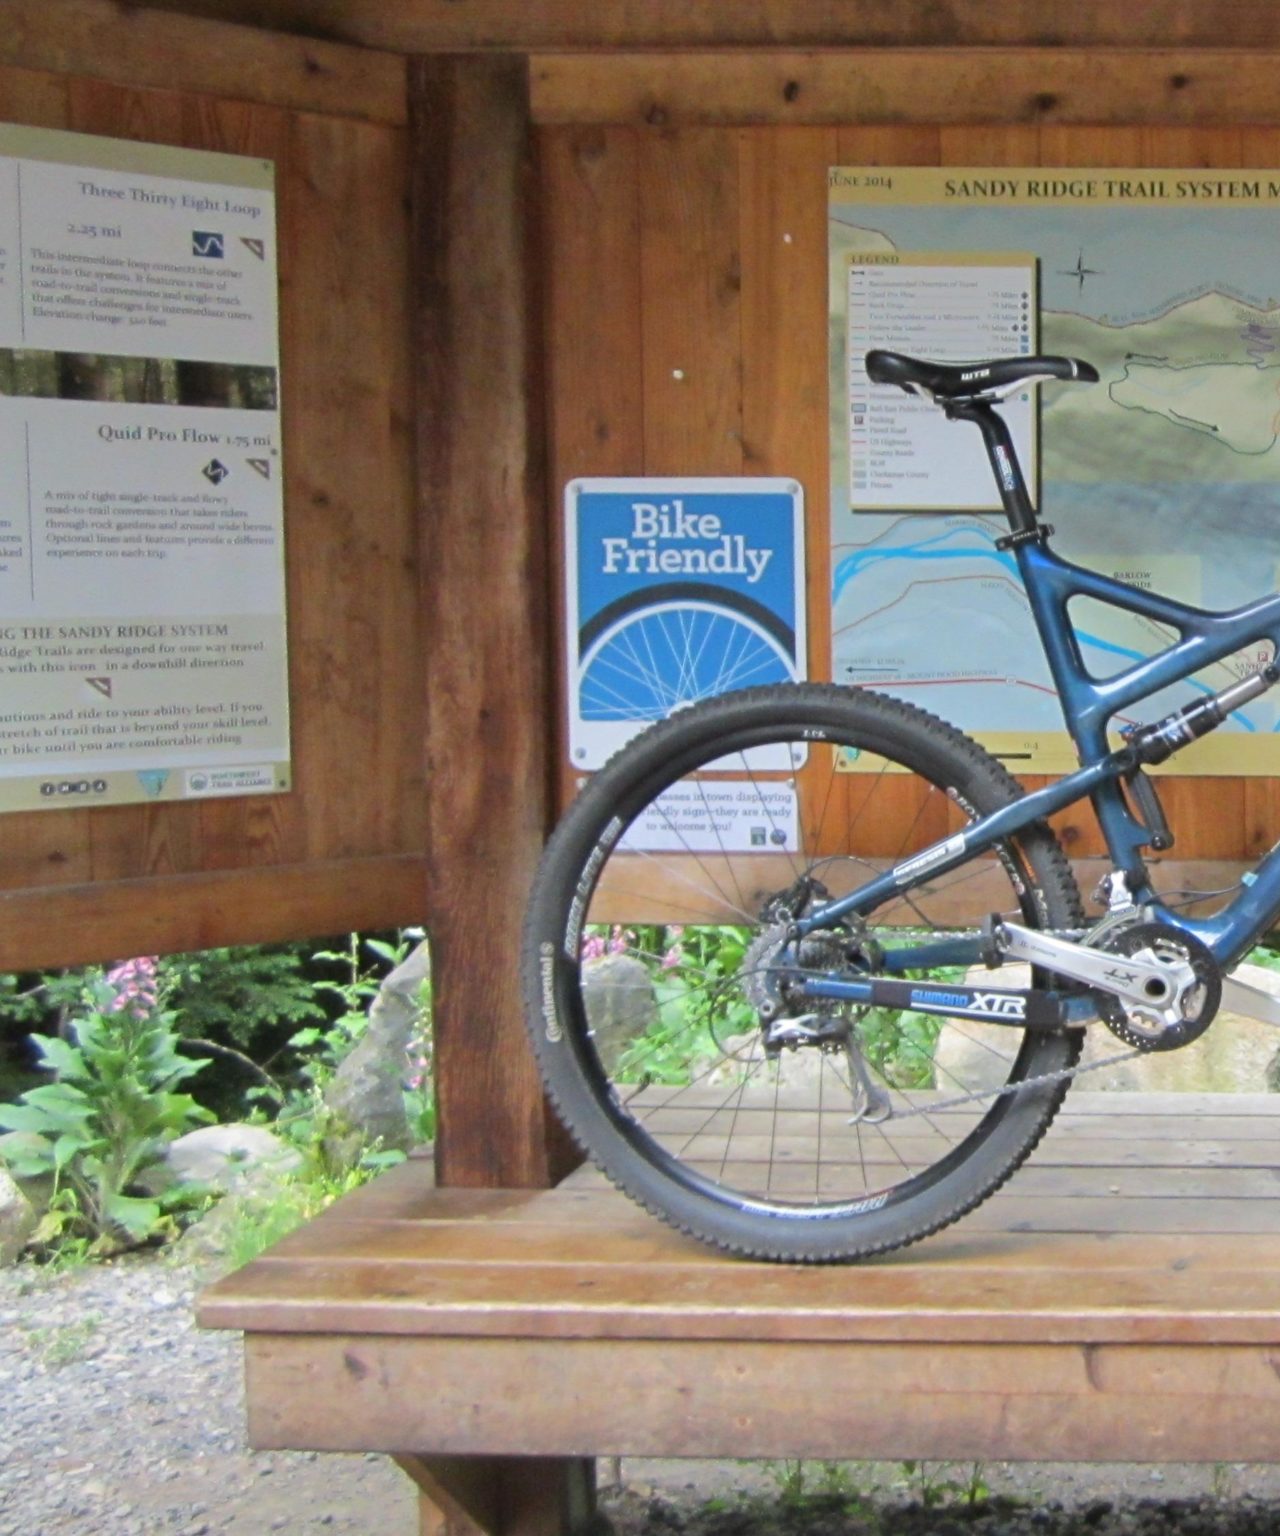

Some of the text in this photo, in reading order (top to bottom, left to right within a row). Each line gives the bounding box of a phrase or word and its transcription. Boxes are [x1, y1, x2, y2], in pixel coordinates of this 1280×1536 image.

[829, 176, 892, 190] JUNE 2014
[945, 180, 1021, 197] SANDY
[1028, 180, 1098, 198] RIDGE
[1104, 180, 1170, 198] TRAIL
[1176, 180, 1263, 199] SYSTEM
[79, 182, 261, 217] Three Thirty Eight Loop
[67, 223, 122, 237] 2.25 mi
[851, 255, 900, 264] LEGEND
[961, 368, 990, 380] WTB
[99, 425, 142, 442] Quid
[148, 427, 176, 441] Pro
[182, 429, 220, 442] Flow
[253, 434, 272, 446] mi
[632, 501, 721, 540] Bike
[602, 535, 773, 583] Friendly
[22, 627, 53, 639] THE
[58, 626, 112, 638] SANDY
[117, 626, 164, 637] RIDGE
[171, 625, 228, 636] SYSTEM
[37, 646, 72, 656] Trails
[98, 644, 158, 657] designed
[160, 644, 175, 653] for
[206, 645, 227, 654] way
[231, 642, 263, 651] travel
[9, 662, 37, 673] with
[41, 662, 65, 672] this
[106, 661, 118, 670] in
[133, 659, 186, 669] downhill
[190, 658, 244, 667] direction
[50, 709, 72, 719] and
[78, 708, 100, 718] ride
[106, 707, 118, 717] to
[122, 709, 148, 719] your
[155, 705, 191, 718] ability
[242, 705, 262, 714] you
[45, 726, 57, 735] of
[62, 724, 88, 734] trail
[92, 723, 117, 733] that
[122, 723, 130, 732] is
[135, 721, 179, 734] beyond
[183, 722, 208, 732] your
[213, 719, 238, 728] skill
[13, 743, 41, 754] bike
[45, 742, 75, 752] until
[80, 743, 102, 753] you
[129, 736, 202, 748] comfortable
[207, 735, 241, 747] riding
[707, 792, 732, 801] town
[736, 791, 792, 803] displaying
[911, 989, 1027, 1015] SHIMANO XTR
